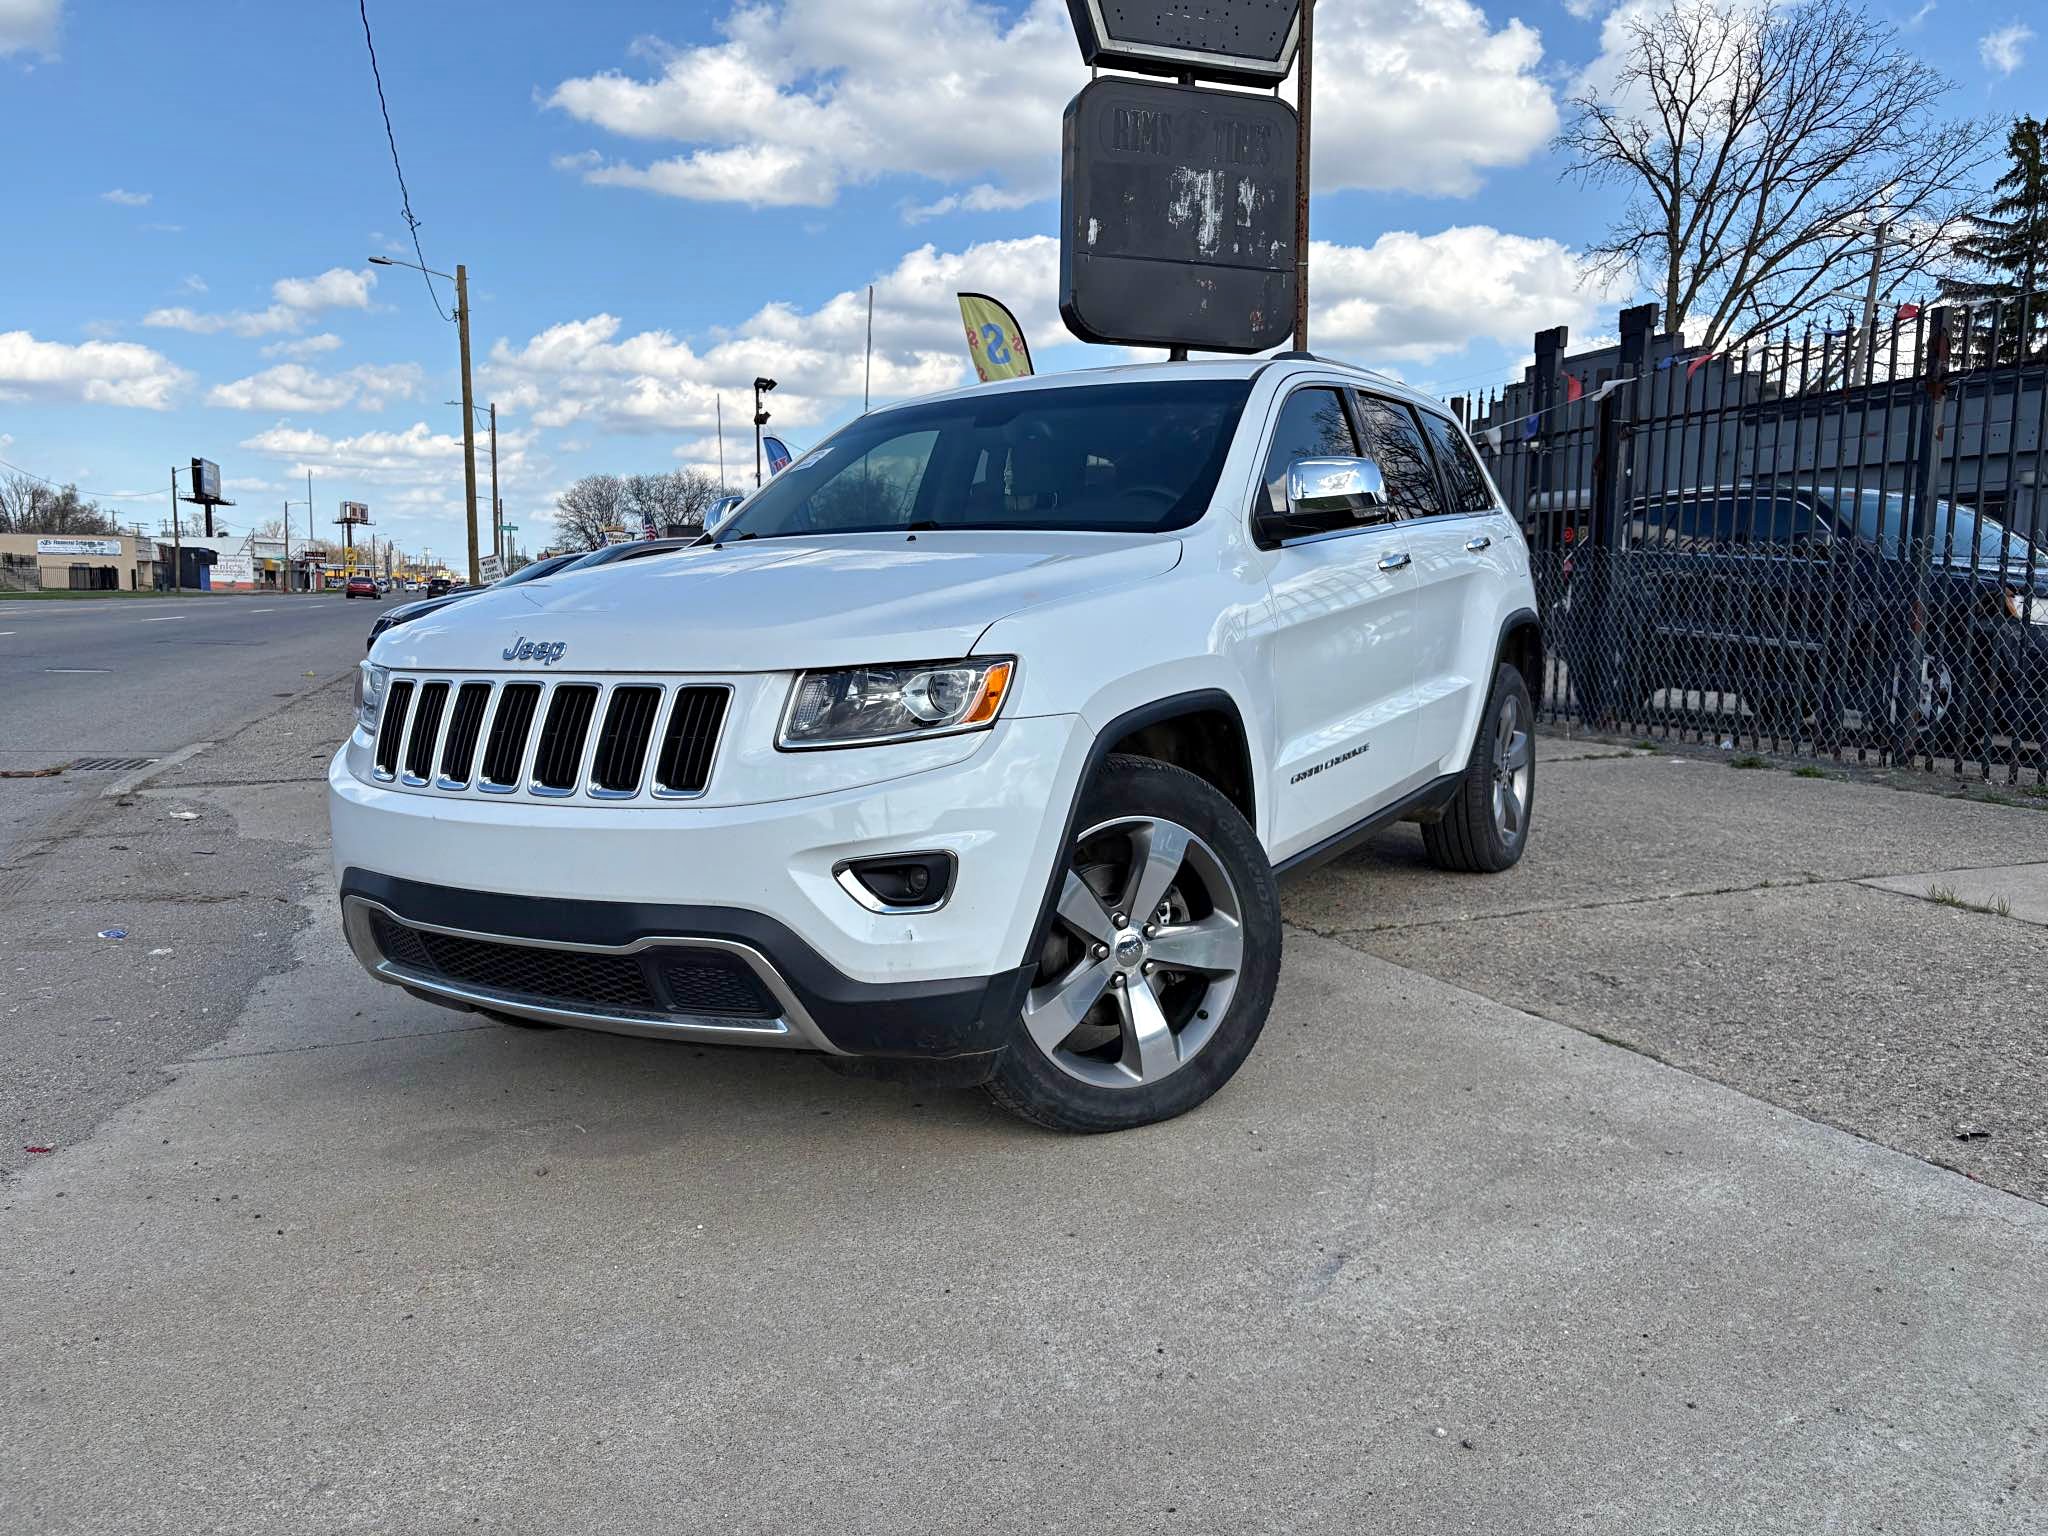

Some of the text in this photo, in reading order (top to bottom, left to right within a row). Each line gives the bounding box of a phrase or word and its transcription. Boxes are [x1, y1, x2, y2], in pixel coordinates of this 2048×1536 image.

[502, 636, 567, 666] Jeep
[1290, 742, 1370, 785] GRAND CHEROKEE
